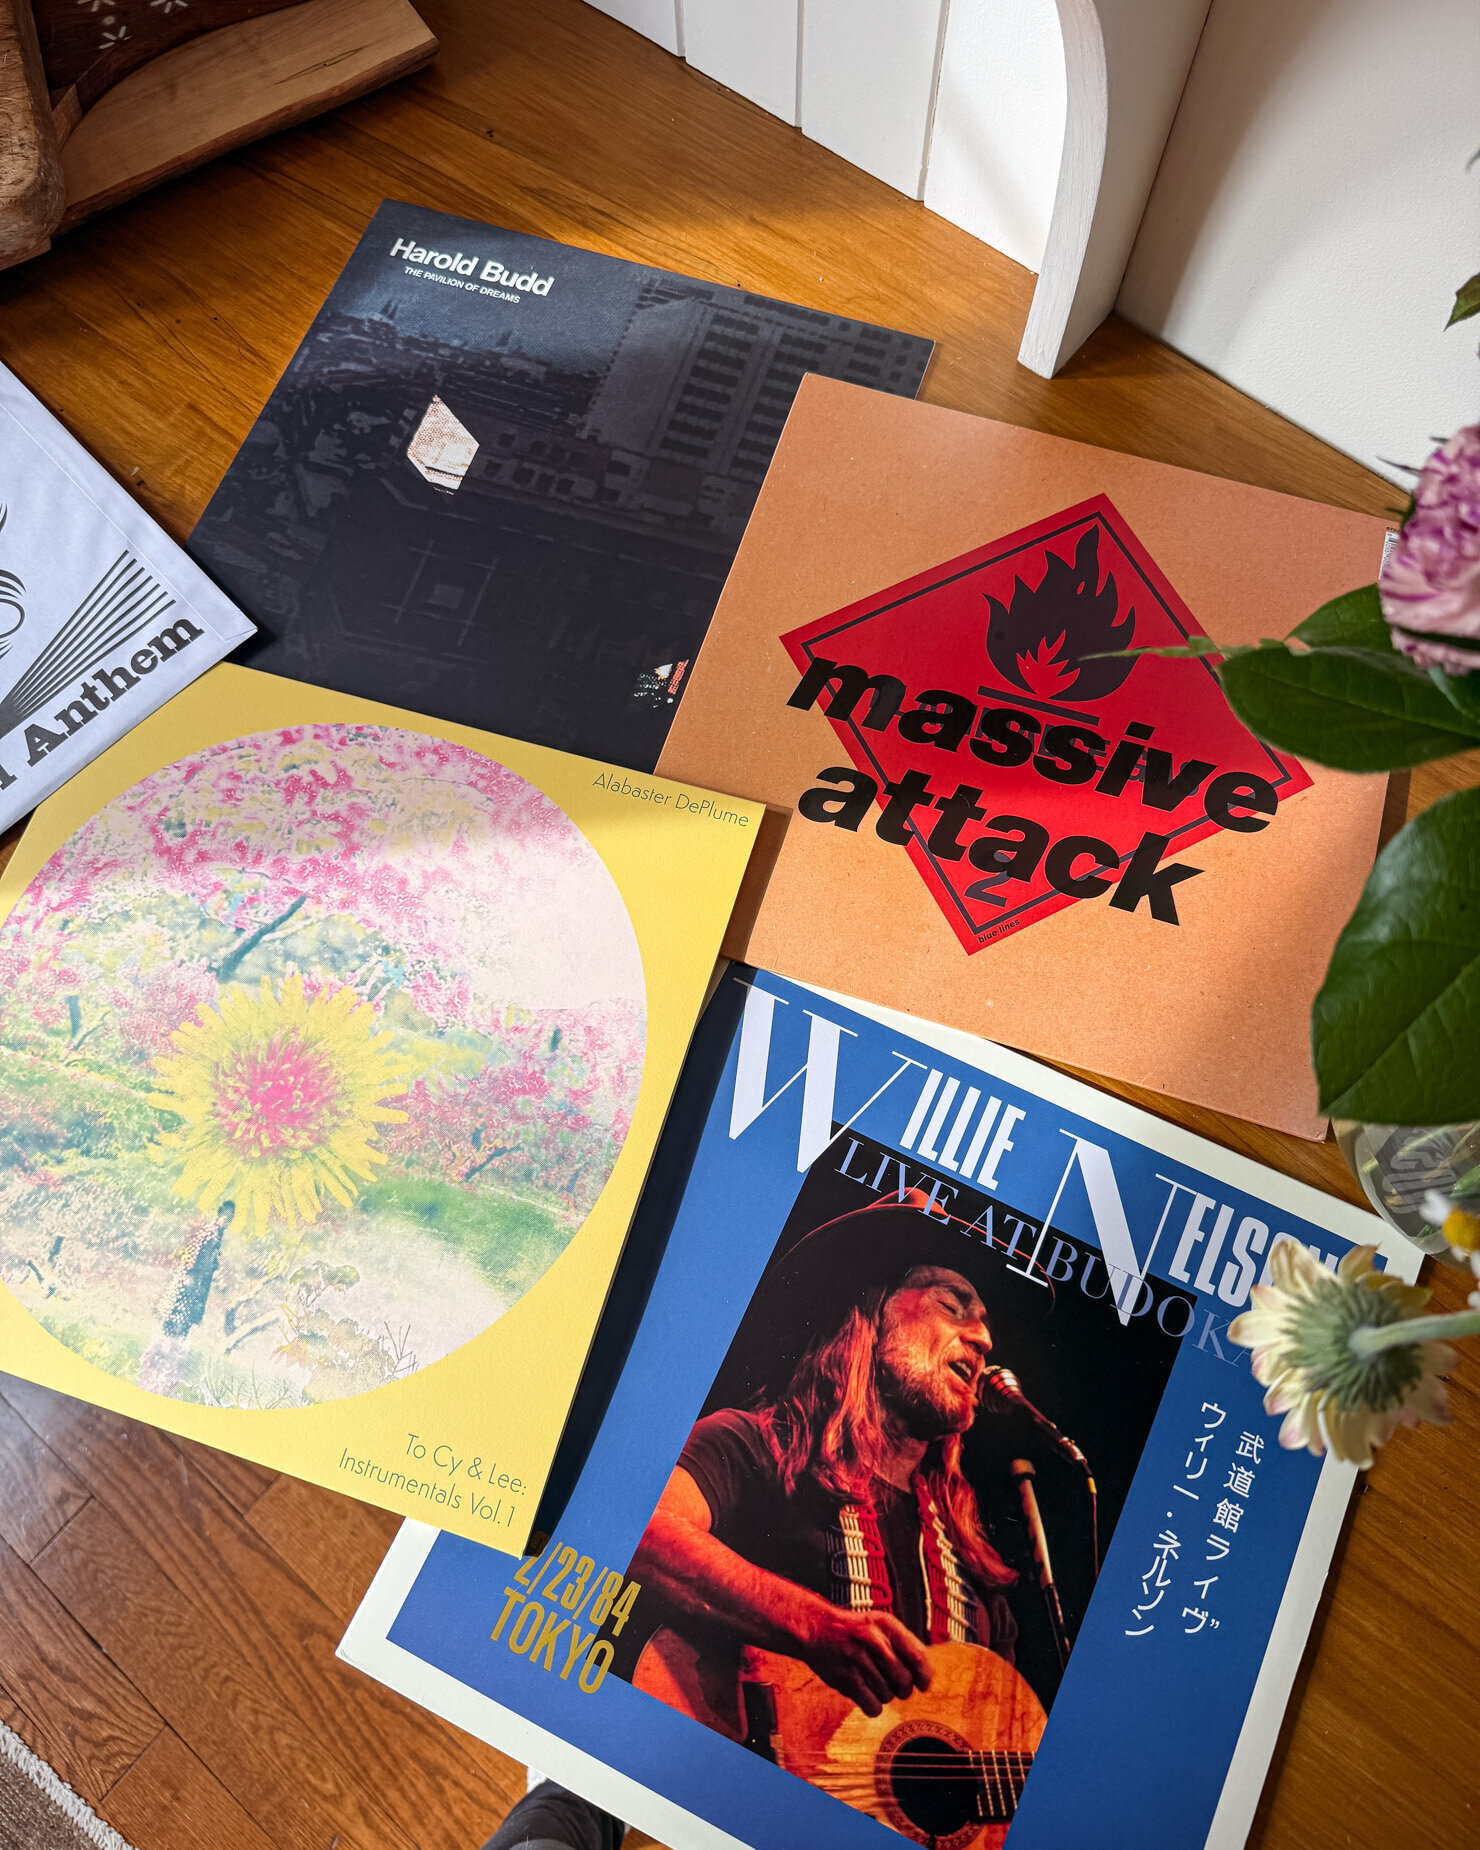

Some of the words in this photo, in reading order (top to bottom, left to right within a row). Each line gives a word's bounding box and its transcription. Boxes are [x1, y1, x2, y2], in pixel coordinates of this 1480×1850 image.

[389, 237, 480, 277] Harold
[479, 260, 555, 297] Budd
[404, 266, 424, 278] THE
[423, 271, 465, 290] PAVILION
[464, 282, 480, 293] OF
[479, 286, 521, 304] DREAMS
[23, 617, 206, 768] Anthem
[785, 655, 1279, 834] massive
[591, 772, 673, 806] Alabaster
[674, 793, 750, 828] DePlume
[797, 766, 1205, 927] attack
[977, 929, 998, 944] blue
[998, 919, 1021, 934] lines
[728, 977, 1027, 1192] WILLIE
[1005, 1128, 1340, 1327] NELS
[833, 1136, 960, 1226] LIVE
[959, 1204, 1039, 1261] AT
[1040, 1236, 1253, 1368] BUDOK
[337, 1447, 462, 1510] Instrumentals
[405, 1432, 427, 1461] To
[432, 1444, 464, 1477] Cy
[466, 1456, 483, 1480] &
[487, 1462, 528, 1496] Lee:
[513, 1530, 642, 1637] 2/23/84
[489, 1586, 616, 1695] TOKYO
